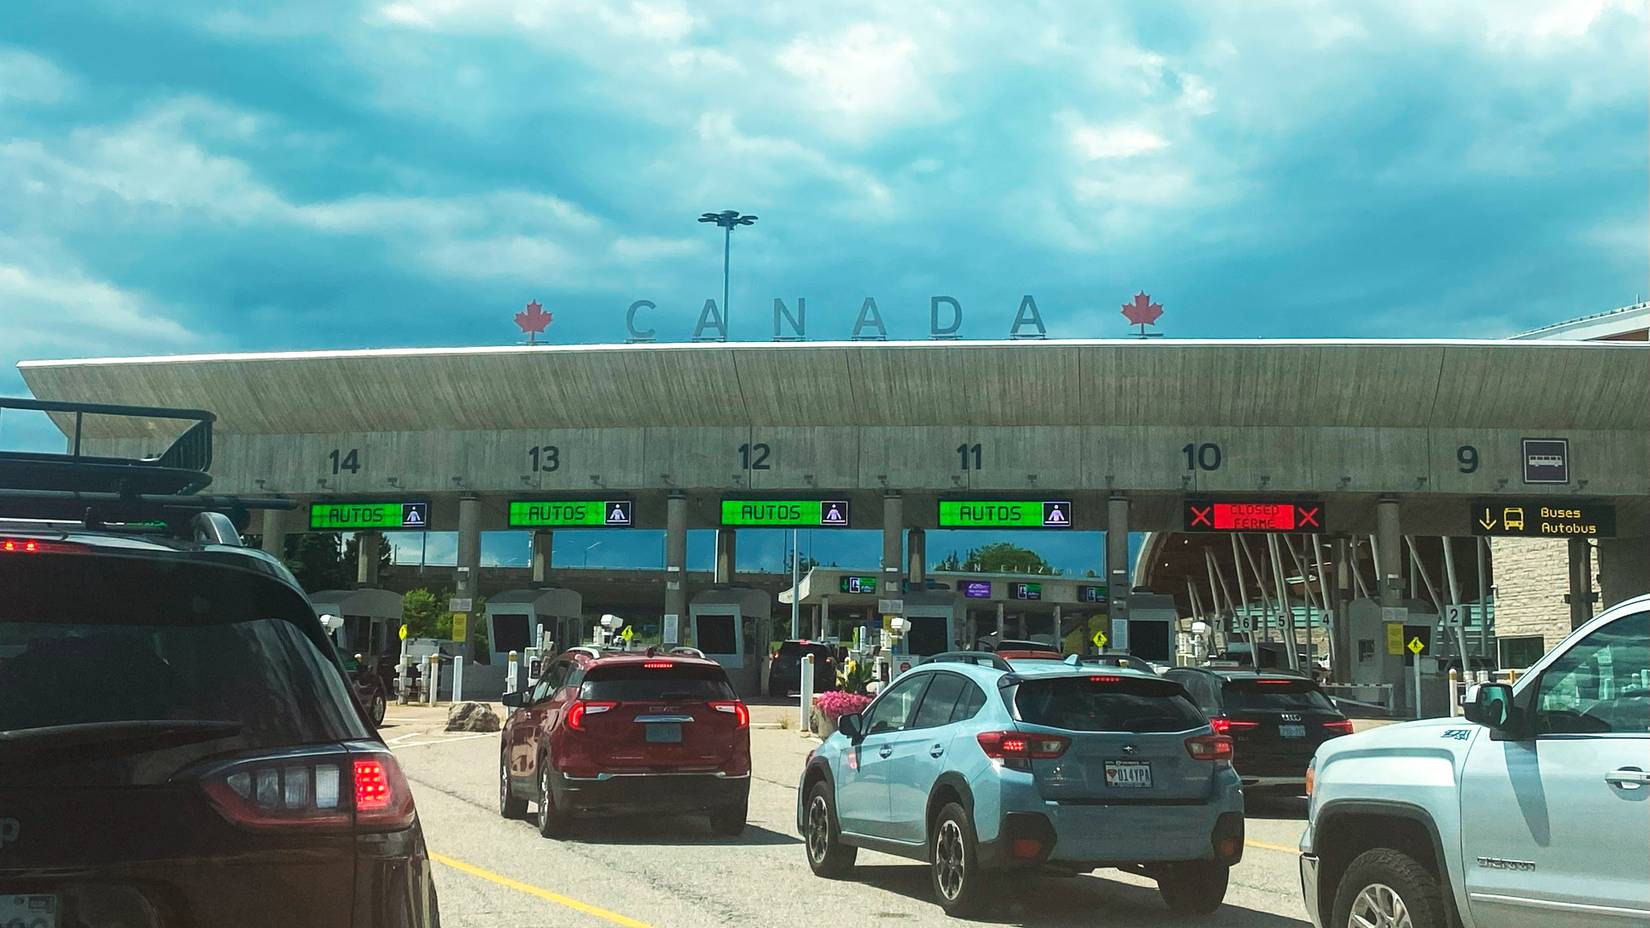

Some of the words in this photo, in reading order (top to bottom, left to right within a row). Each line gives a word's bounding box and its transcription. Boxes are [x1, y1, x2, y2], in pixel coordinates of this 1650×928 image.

[626, 295, 1047, 338] CANADA
[329, 449, 361, 475] 14
[529, 446, 560, 473] 13
[739, 443, 771, 470] 12
[957, 443, 982, 470] 11
[1182, 443, 1221, 470] 10
[1457, 446, 1479, 474] 9
[328, 508, 384, 523] AUTOS
[529, 505, 586, 521] AUTOS
[742, 505, 801, 520] AUTOS
[960, 505, 1022, 521] AUTOS
[1231, 504, 1280, 515] CLOSED
[1541, 507, 1581, 518] Buses
[1234, 518, 1276, 529] FERME
[1542, 522, 1597, 534] Autobus
[1278, 615, 1286, 627] 5
[1322, 613, 1330, 626] 4
[1450, 608, 1458, 622] 2
[1215, 620, 1221, 629] 7
[1243, 618, 1250, 629] 6
